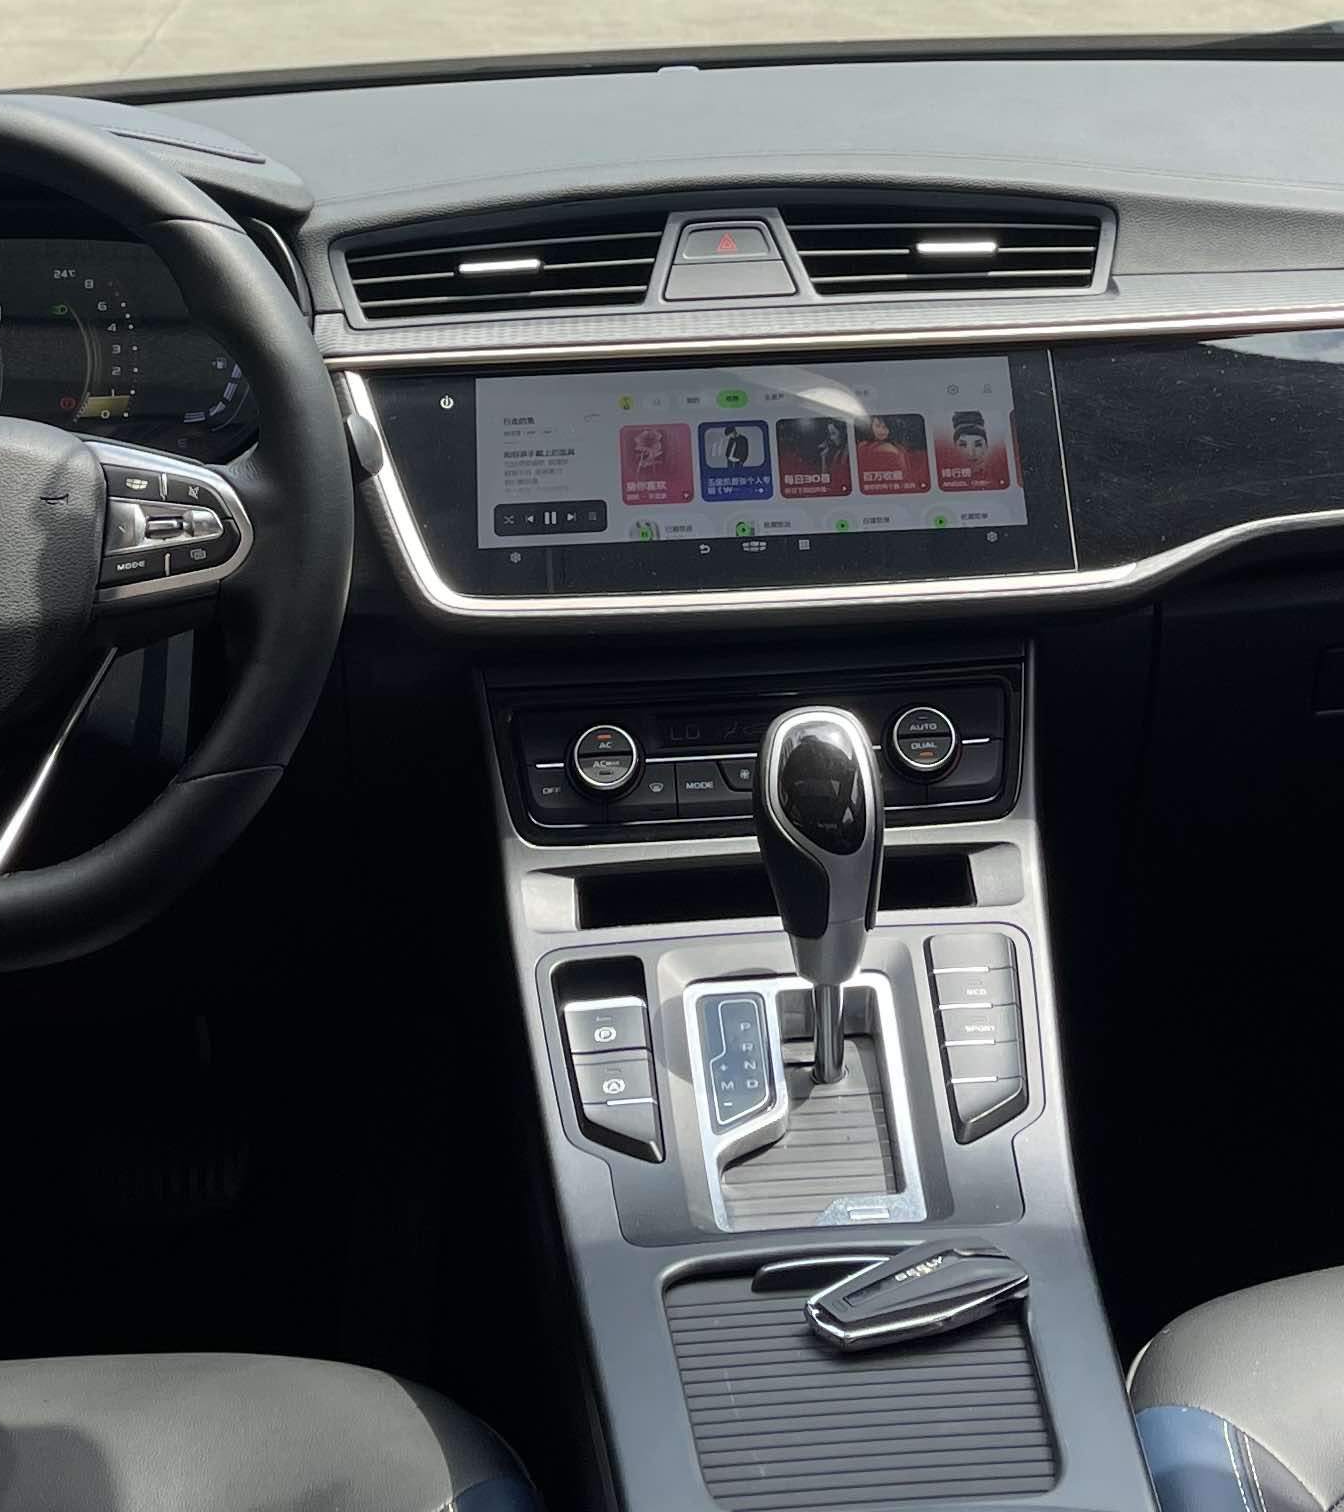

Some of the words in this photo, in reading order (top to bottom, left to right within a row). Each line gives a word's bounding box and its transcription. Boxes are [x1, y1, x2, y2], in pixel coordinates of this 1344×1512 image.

[97, 301, 108, 312] 6
[107, 322, 118, 333] 4
[111, 344, 121, 355] 3
[111, 366, 122, 376] 2
[117, 560, 146, 571] MODE
[909, 722, 937, 731] AUTO
[598, 741, 613, 750] AC
[910, 741, 937, 750] DUAL
[685, 780, 713, 790] MODE
[740, 1021, 752, 1031] P
[742, 1042, 754, 1052] R
[744, 1060, 757, 1070] N
[720, 1079, 735, 1091] M
[746, 1079, 759, 1089] D
